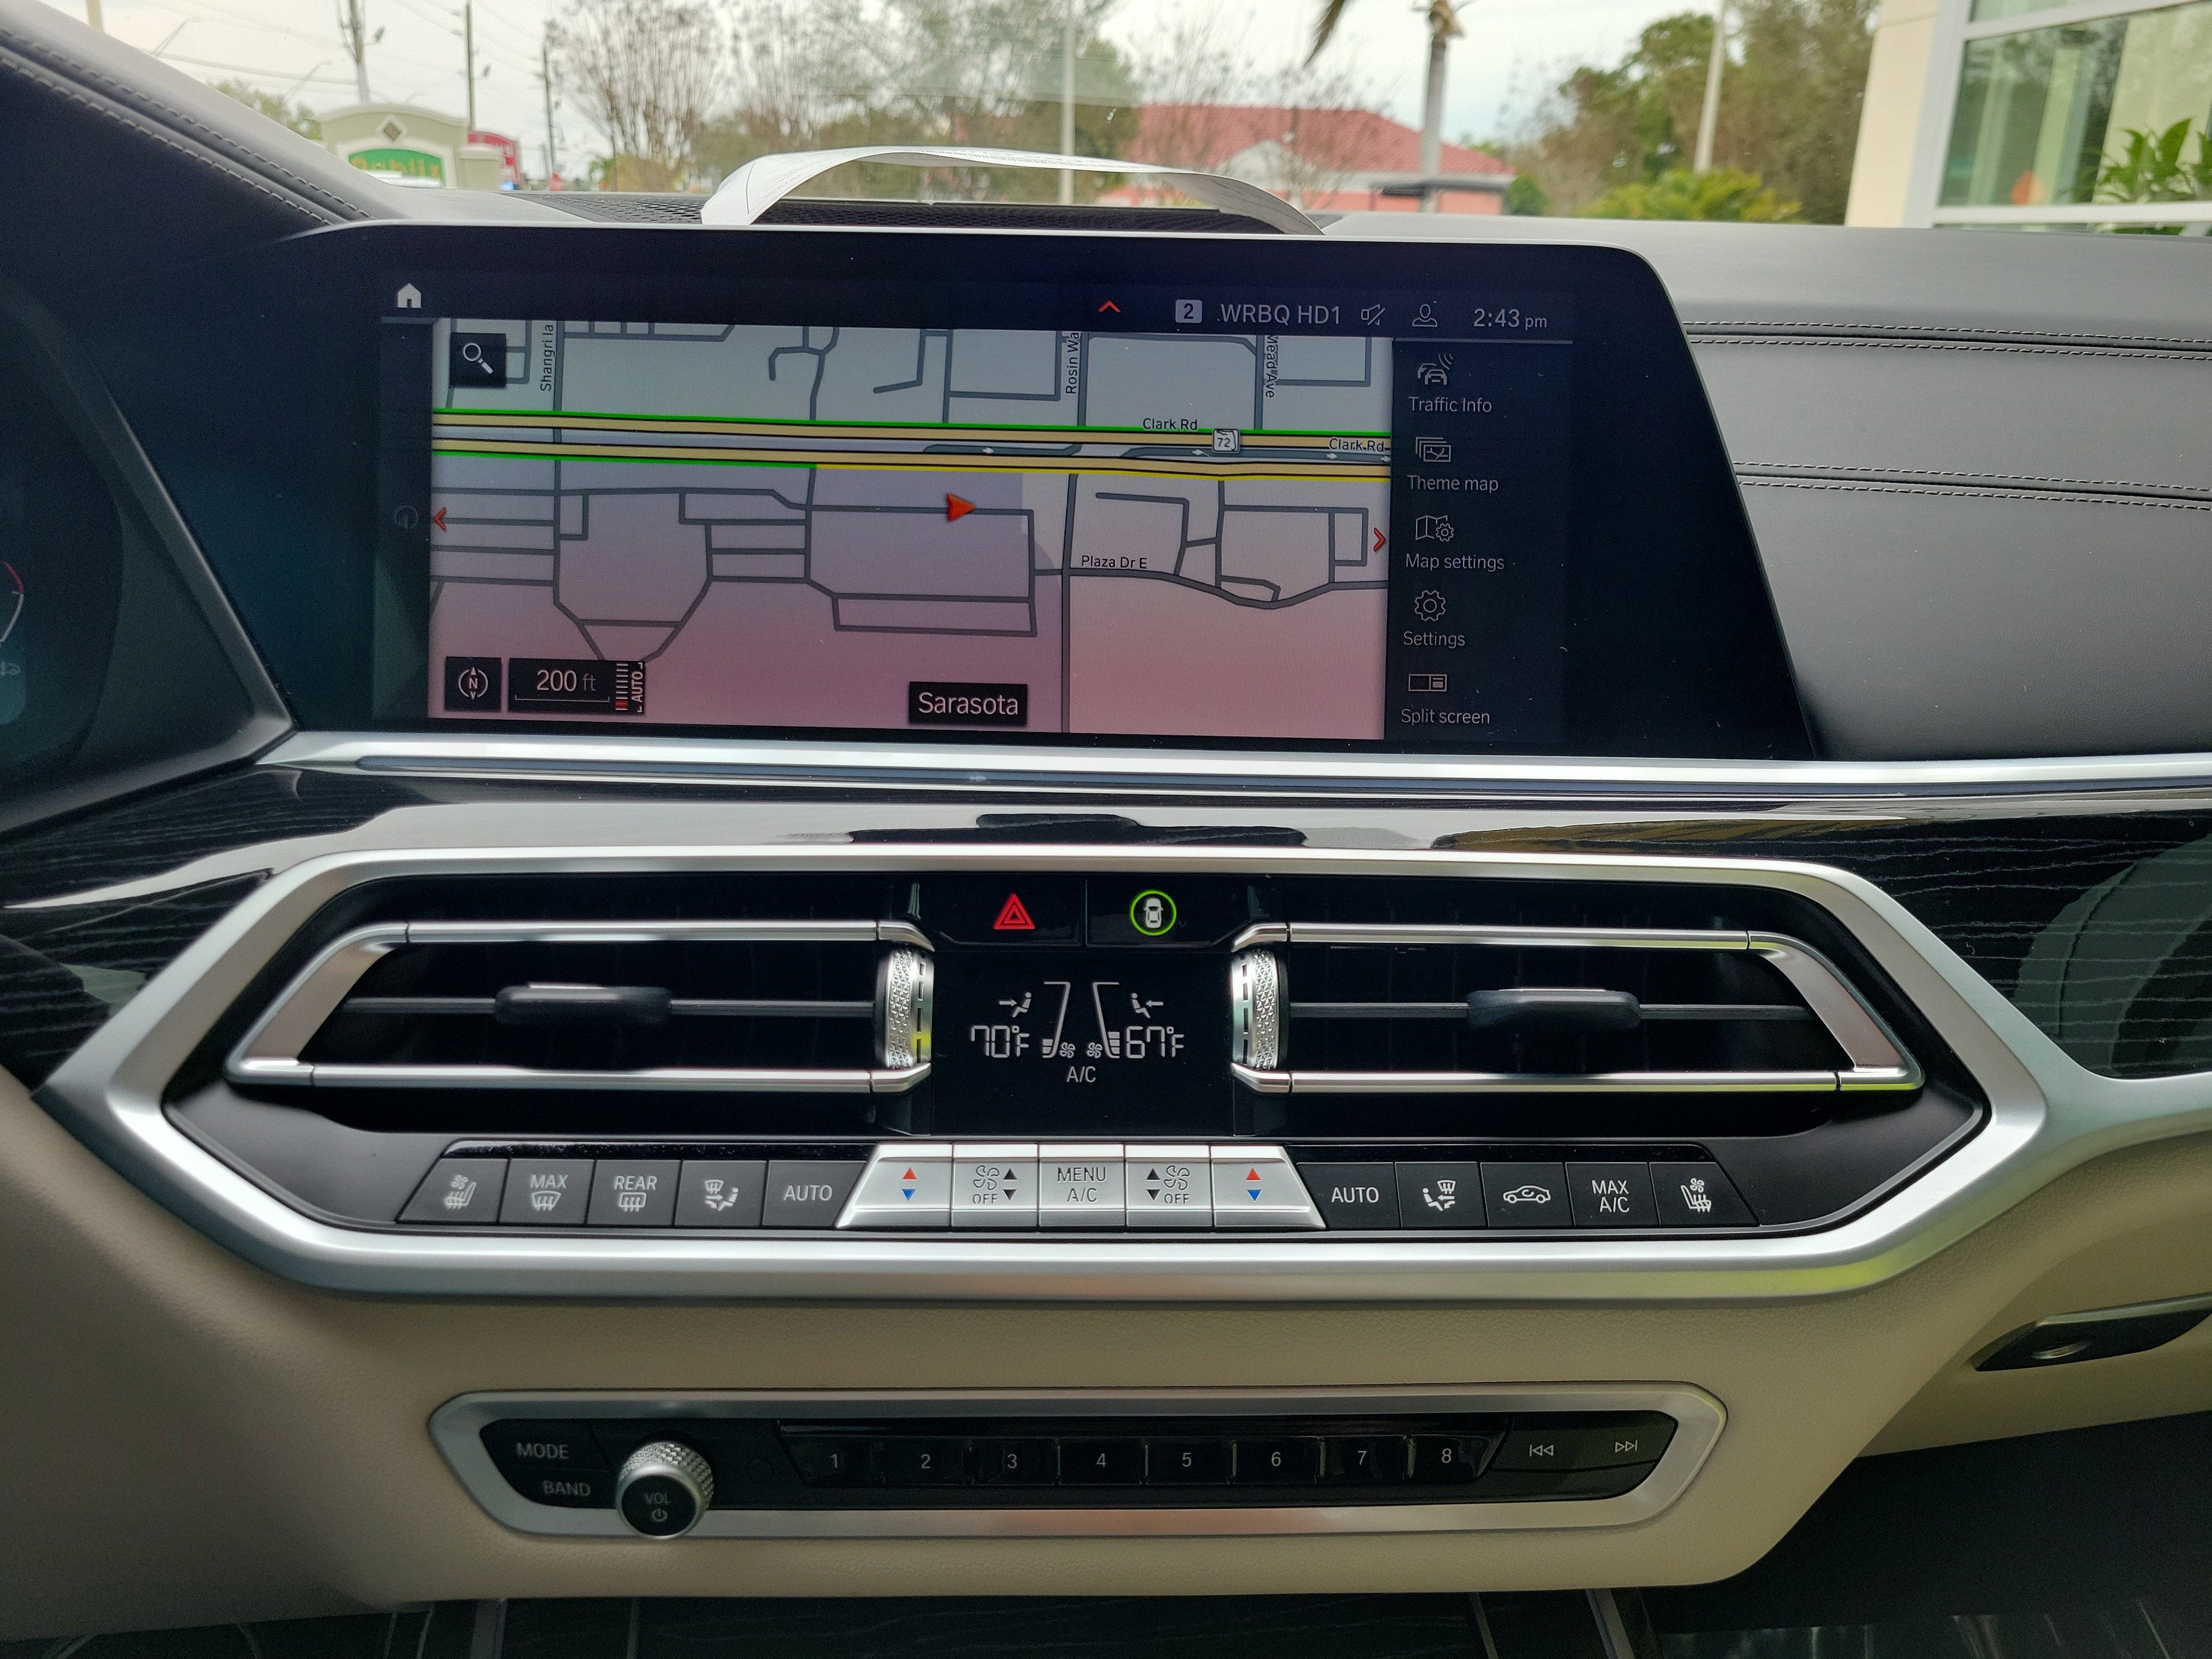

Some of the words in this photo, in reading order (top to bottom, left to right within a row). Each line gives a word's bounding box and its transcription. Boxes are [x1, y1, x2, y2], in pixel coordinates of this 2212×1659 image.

[1183, 304, 1194, 319] 2
[1221, 304, 1290, 325] WRBQ
[1298, 306, 1340, 324] HD1
[1474, 309, 1520, 328] 2:43
[1525, 317, 1547, 329] pm
[1067, 332, 1079, 353] Wa
[1266, 335, 1278, 369] Mead
[540, 340, 555, 391] Shangri
[1065, 357, 1079, 394] Rosin
[1265, 373, 1277, 398] Ave
[1409, 396, 1458, 414] Traffic
[1462, 397, 1492, 414] Info
[1143, 417, 1176, 430] Clark
[1181, 419, 1198, 431] Rd
[1217, 437, 1231, 448] 72
[1329, 438, 1363, 450] Clark
[1367, 440, 1384, 452] Rd
[1407, 475, 1459, 491] Theme
[1464, 479, 1498, 494] map
[1081, 556, 1116, 569] Plaza
[1120, 556, 1136, 568] Dr
[1139, 557, 1147, 568] E
[1406, 554, 1438, 569] Map
[1444, 554, 1505, 571] settings
[1403, 631, 1465, 648] Settings
[469, 677, 478, 689] N
[537, 670, 577, 691] 200
[583, 673, 597, 691] ft
[631, 671, 643, 703] AUTO
[918, 692, 1018, 716] Sarasota
[1401, 709, 1435, 725] Split
[1440, 710, 1490, 724] screen
[1066, 1066, 1096, 1083] A/C
[531, 1174, 567, 1189] MAX
[614, 1175, 657, 1190] REAR
[1058, 1167, 1107, 1183] MENU
[783, 1184, 832, 1201] AUTO
[1066, 1188, 1097, 1203] A/C
[1331, 1187, 1379, 1204] AUTO
[1592, 1180, 1628, 1195] MAX
[973, 1194, 998, 1205] OFF
[1164, 1194, 1189, 1205] OFF
[1599, 1197, 1630, 1213] A/C
[516, 1443, 569, 1460] MODE
[1271, 1451, 1281, 1466] 6
[1357, 1451, 1367, 1465] 7
[1442, 1448, 1452, 1463] 8
[831, 1453, 839, 1468] 1
[921, 1454, 931, 1469] 2
[1007, 1454, 1017, 1469] 3
[1096, 1454, 1107, 1468] 4
[1182, 1453, 1192, 1468] 5
[544, 1481, 591, 1497] BAND
[644, 1493, 670, 1504] VOL
